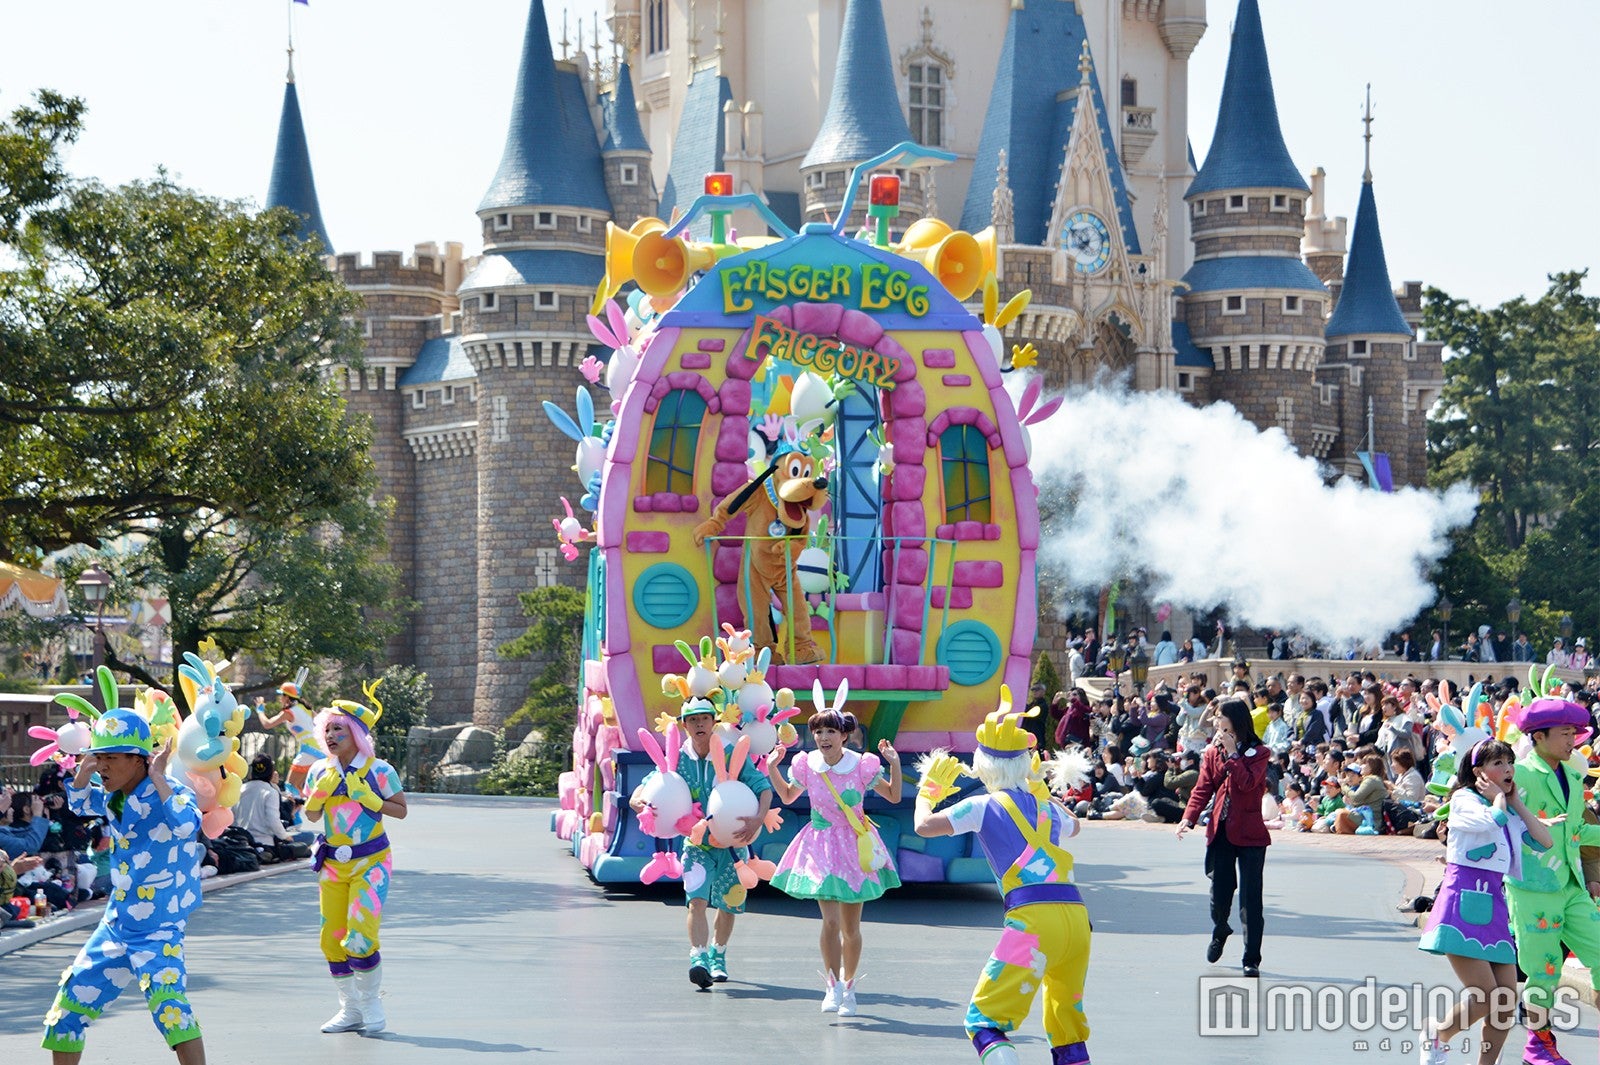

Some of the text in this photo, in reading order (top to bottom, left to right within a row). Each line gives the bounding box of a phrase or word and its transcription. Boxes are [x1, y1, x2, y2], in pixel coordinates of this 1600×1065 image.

[719, 260, 930, 317] EASTER EGG
[743, 314, 902, 392] FACTORY
